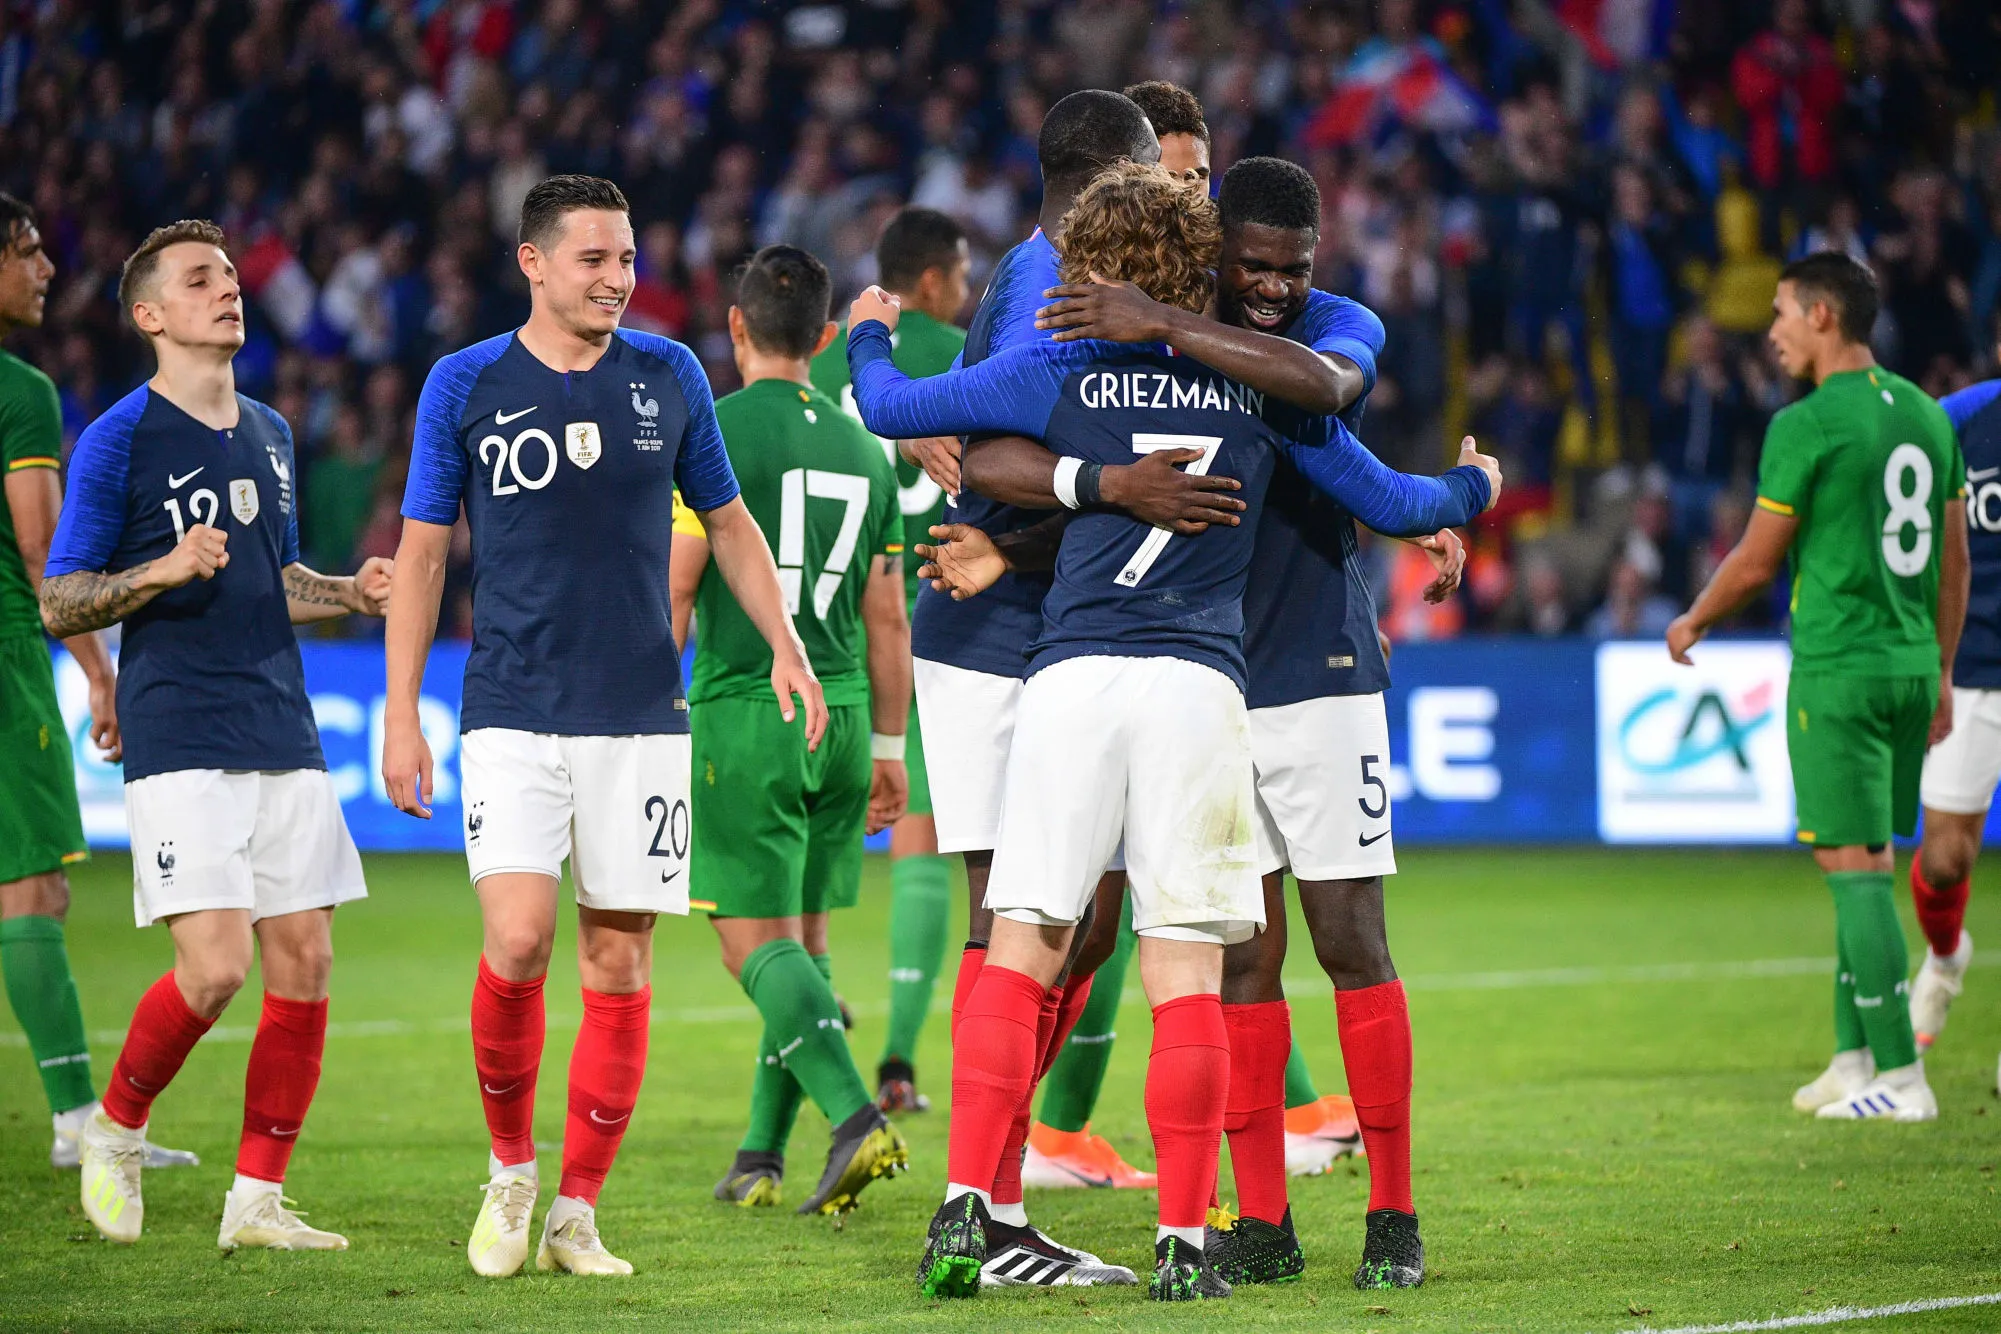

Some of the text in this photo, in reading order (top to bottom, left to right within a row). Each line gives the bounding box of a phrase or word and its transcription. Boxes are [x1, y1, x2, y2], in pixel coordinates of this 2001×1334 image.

[1079, 372, 1265, 419] GRIEZMANN
[478, 428, 558, 496] 20
[1113, 433, 1223, 588] 7
[1881, 442, 1933, 577] 8
[778, 467, 870, 621] 17
[1358, 755, 1387, 819] 5
[644, 795, 689, 860] 20
